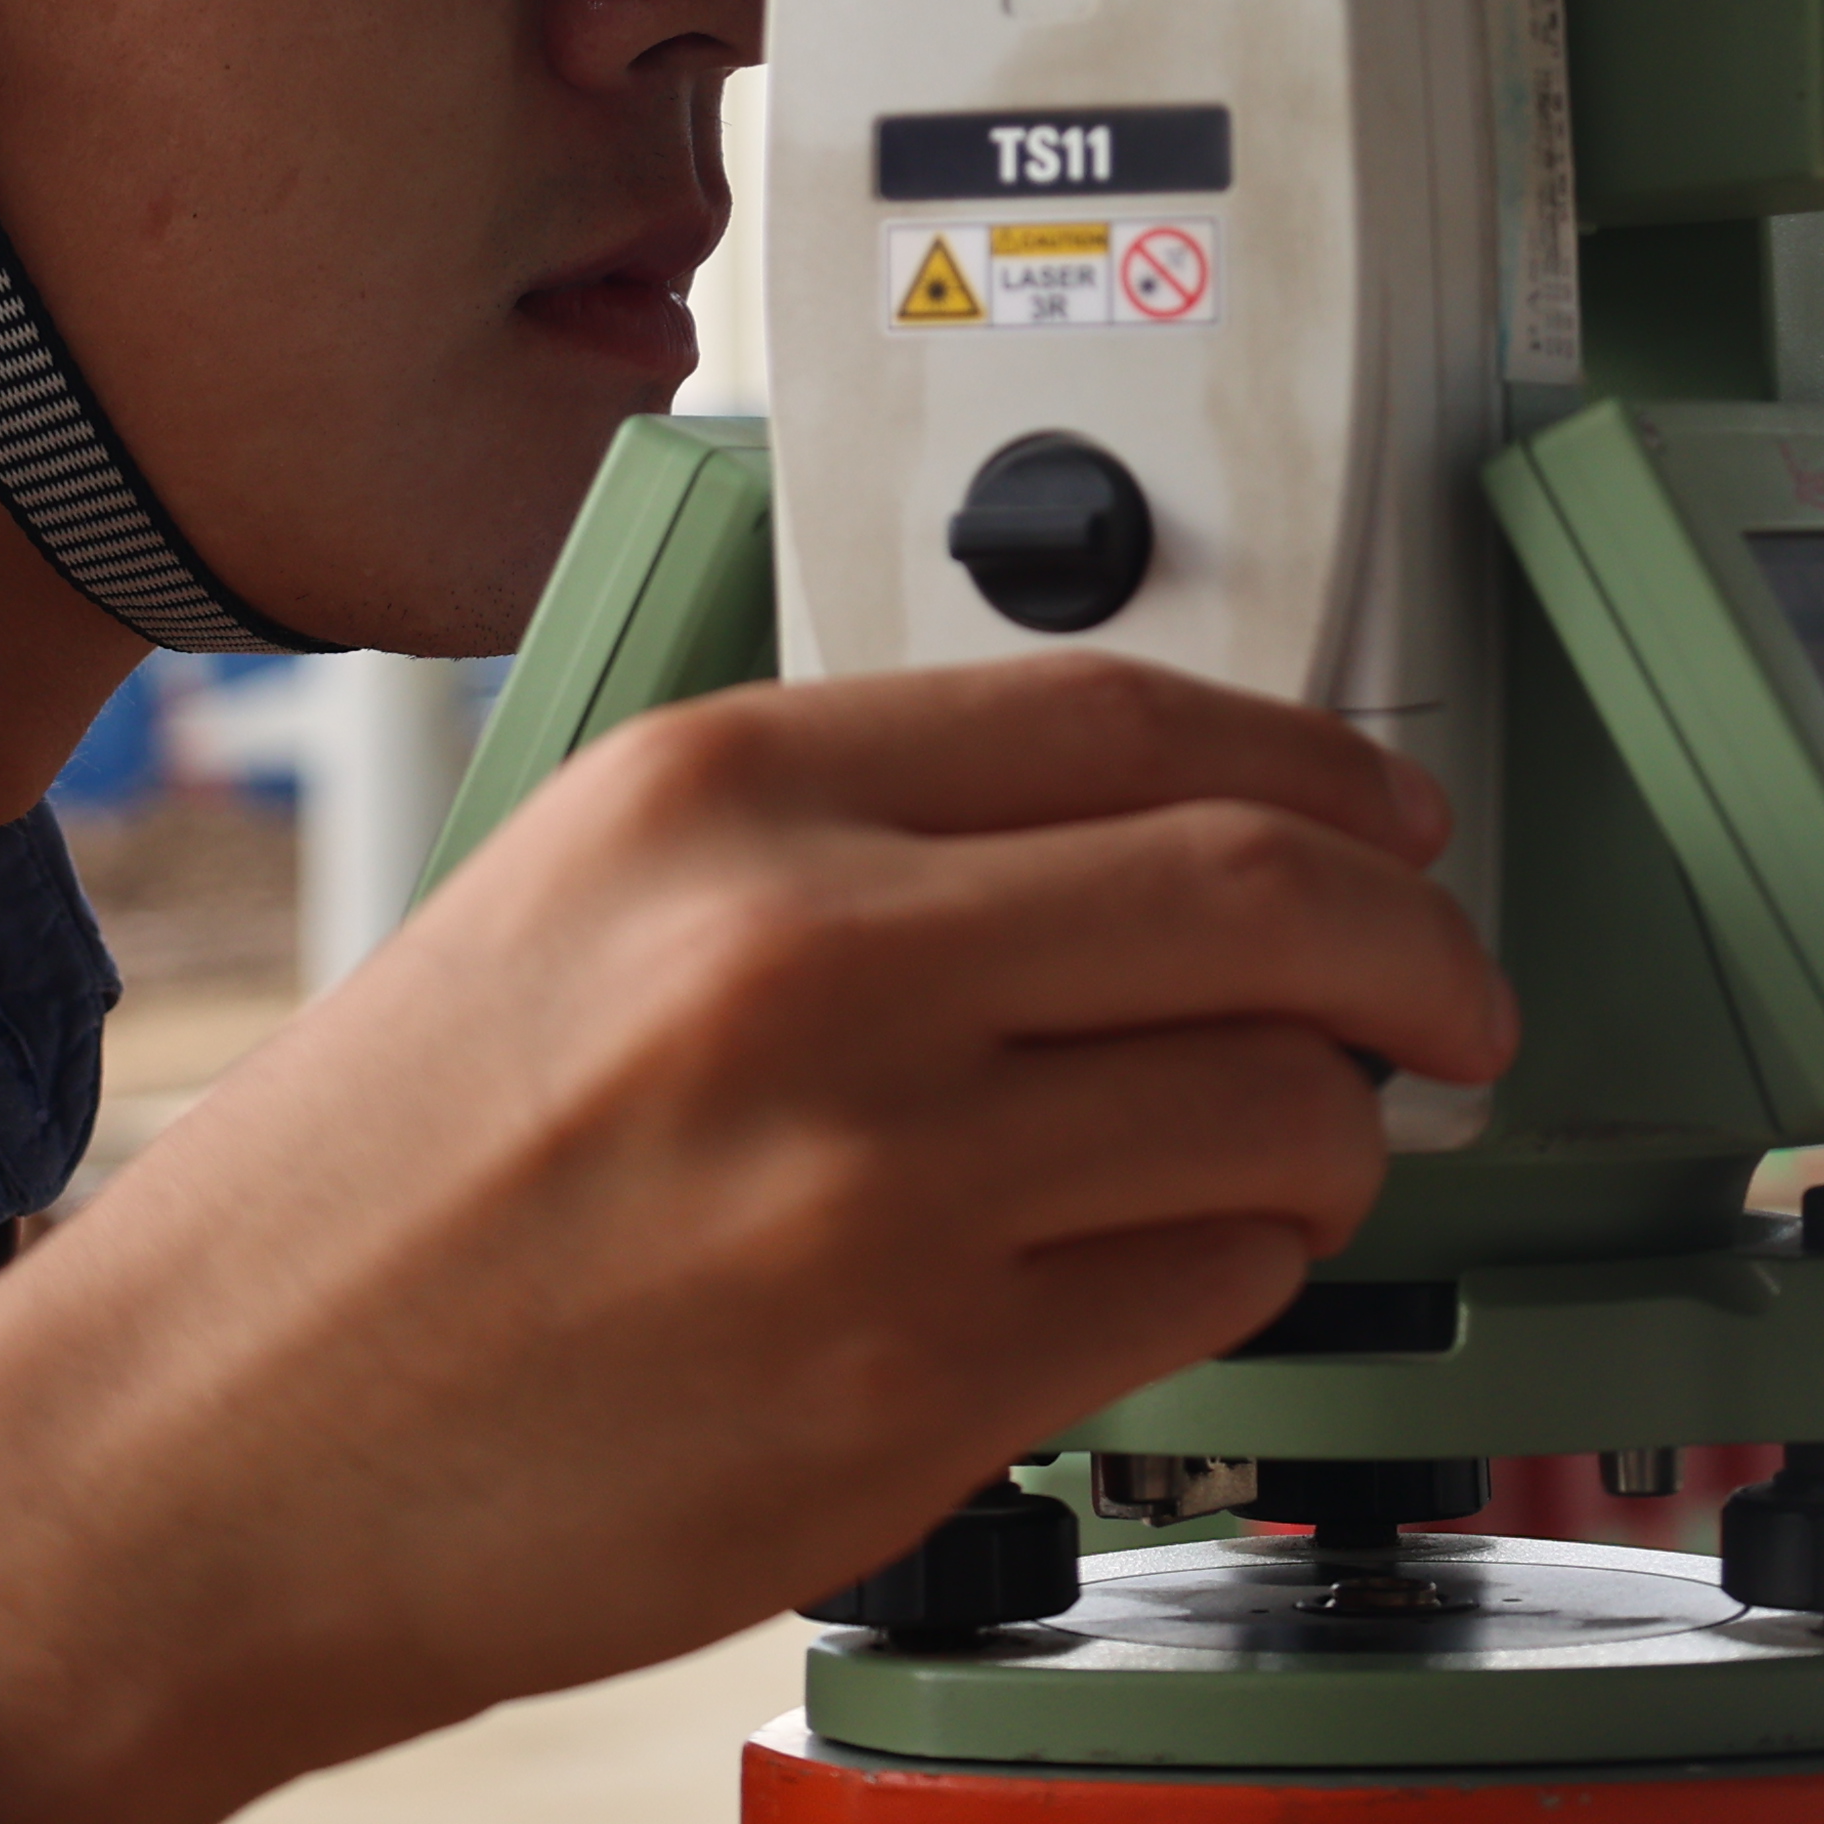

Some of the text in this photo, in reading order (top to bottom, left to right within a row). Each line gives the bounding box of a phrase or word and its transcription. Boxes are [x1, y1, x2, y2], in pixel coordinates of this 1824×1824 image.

[989, 124, 1112, 184] TS11
[1001, 263, 1096, 290] LASER
[1031, 293, 1068, 320] 3R
